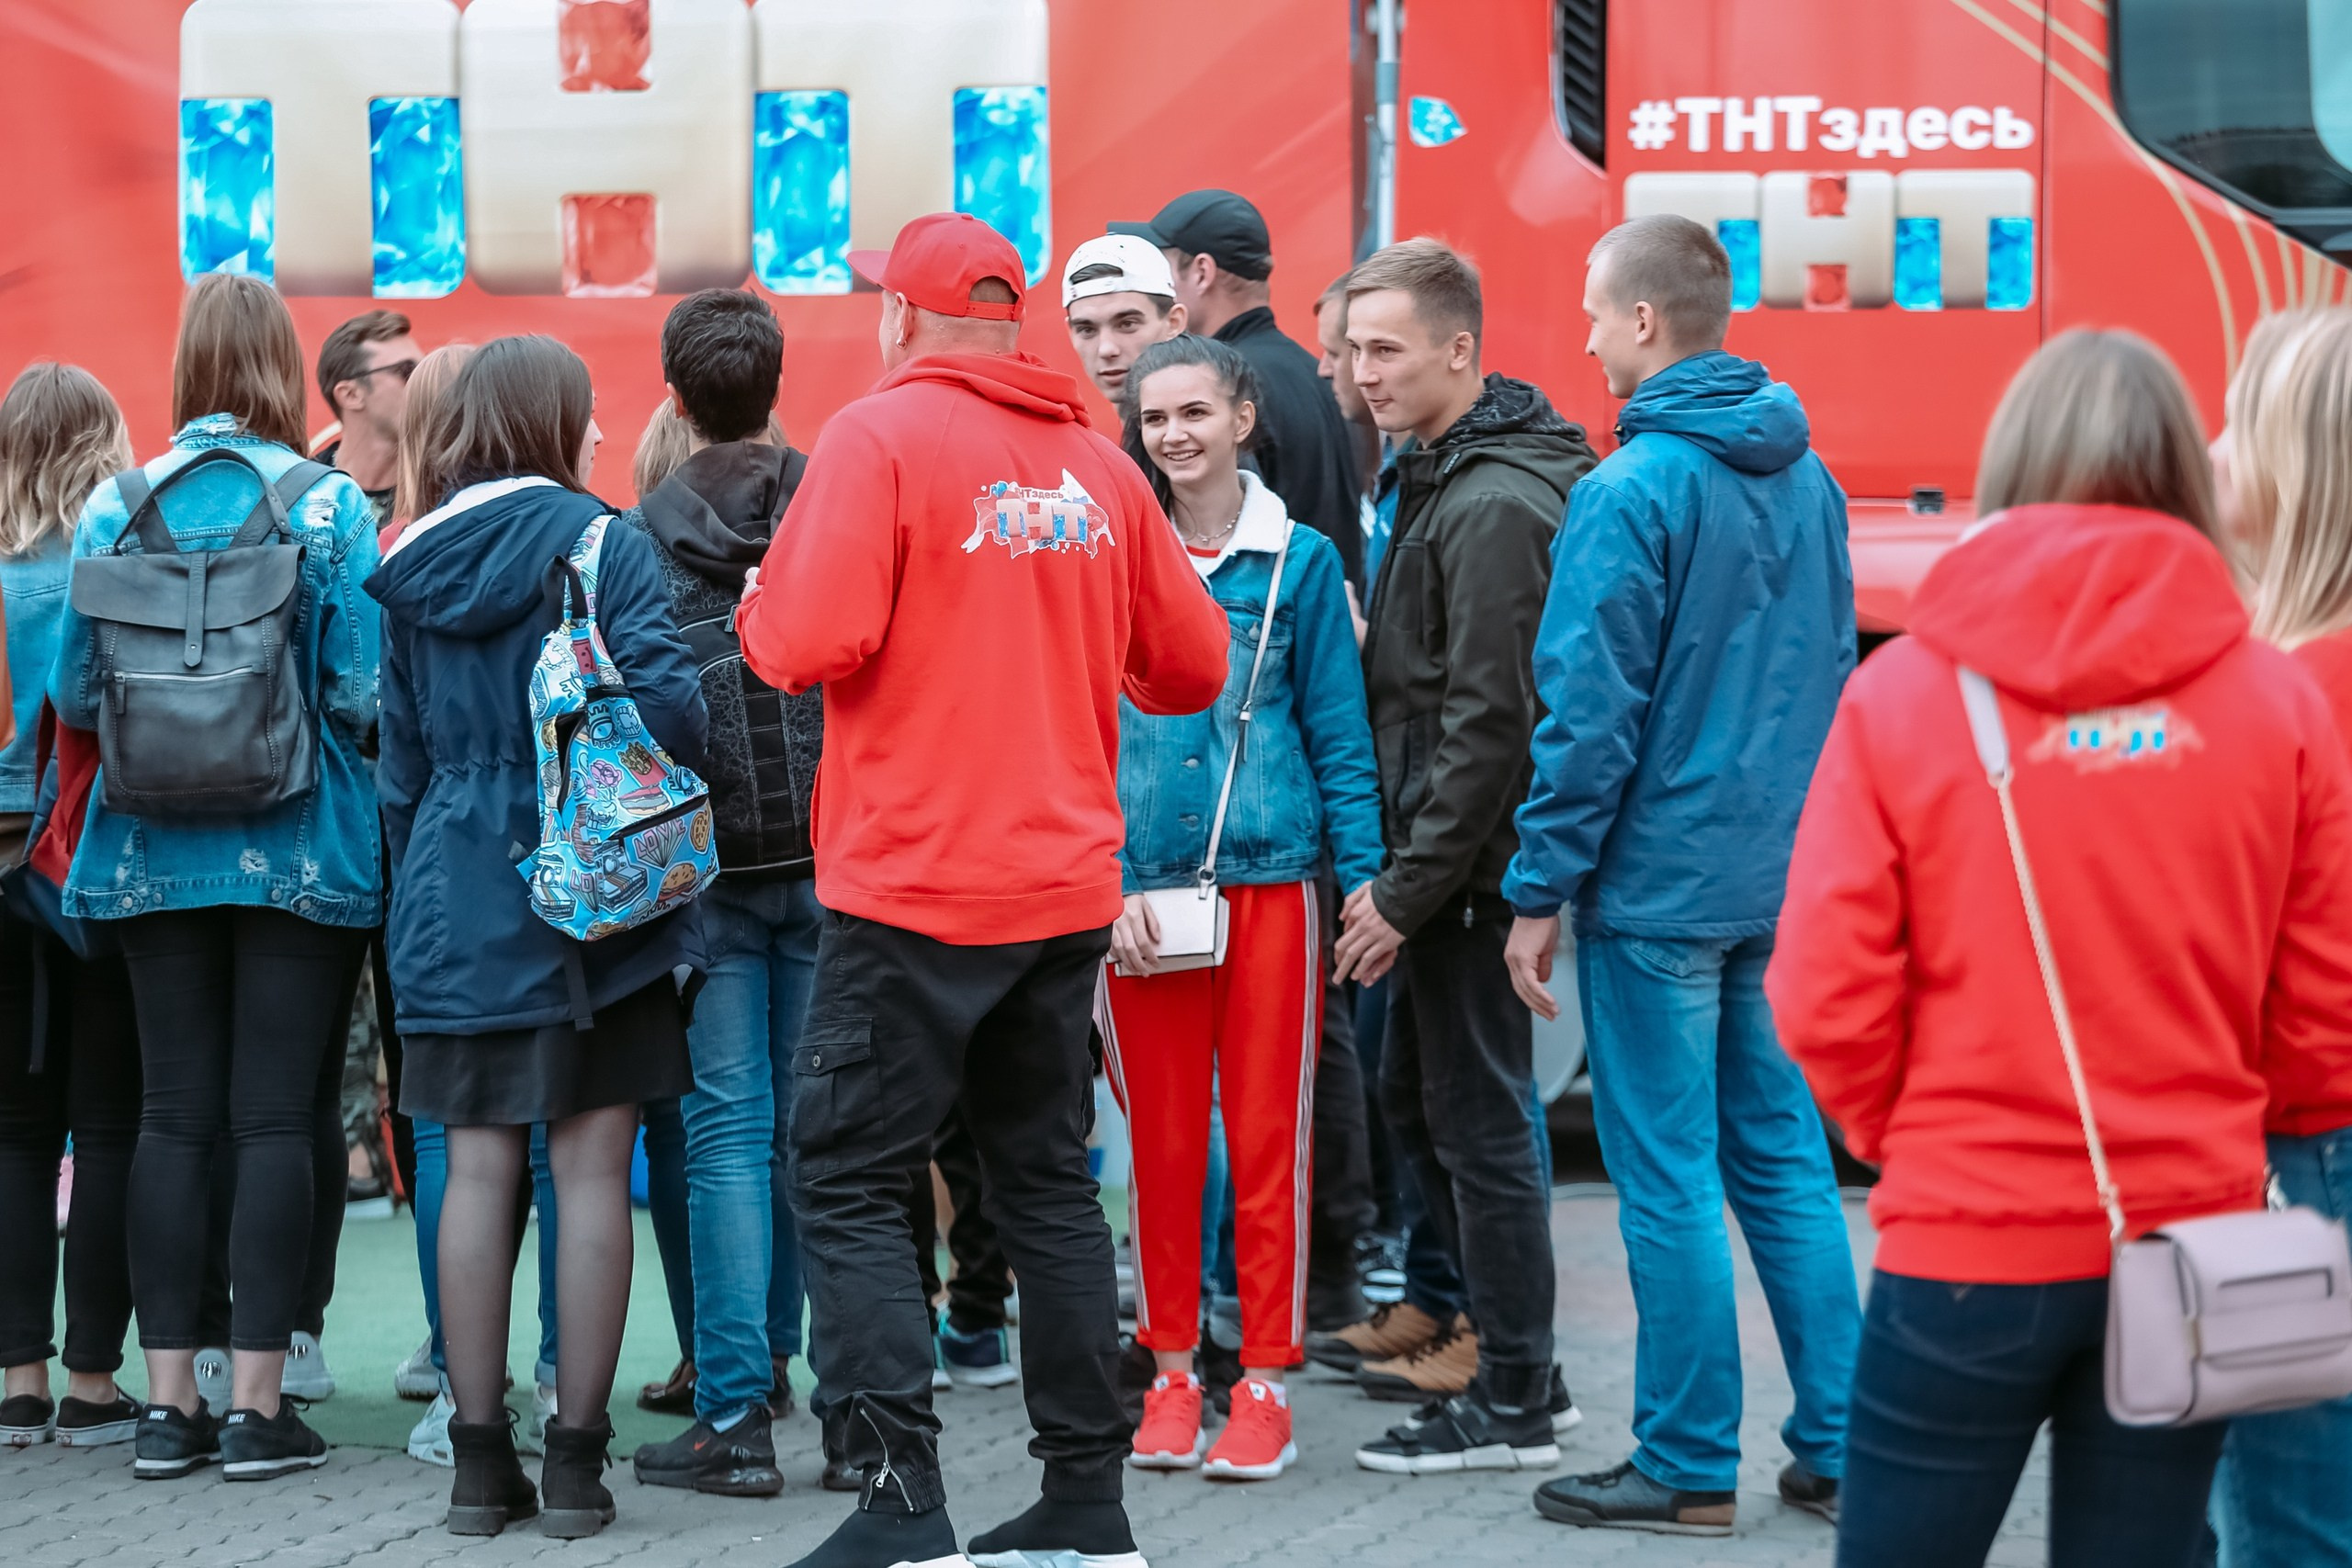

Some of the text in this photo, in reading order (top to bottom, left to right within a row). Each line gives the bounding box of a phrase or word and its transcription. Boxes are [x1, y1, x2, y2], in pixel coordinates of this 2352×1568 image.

[1628, 96, 2034, 158] #ТНТздесь
[180, 0, 1052, 298] ТНТ
[997, 499, 1087, 542] ТНТ
[634, 818, 686, 859] LOVE
[570, 869, 595, 892] LO
[149, 1410, 167, 1421] NIKE
[228, 1414, 245, 1424] NIKE
